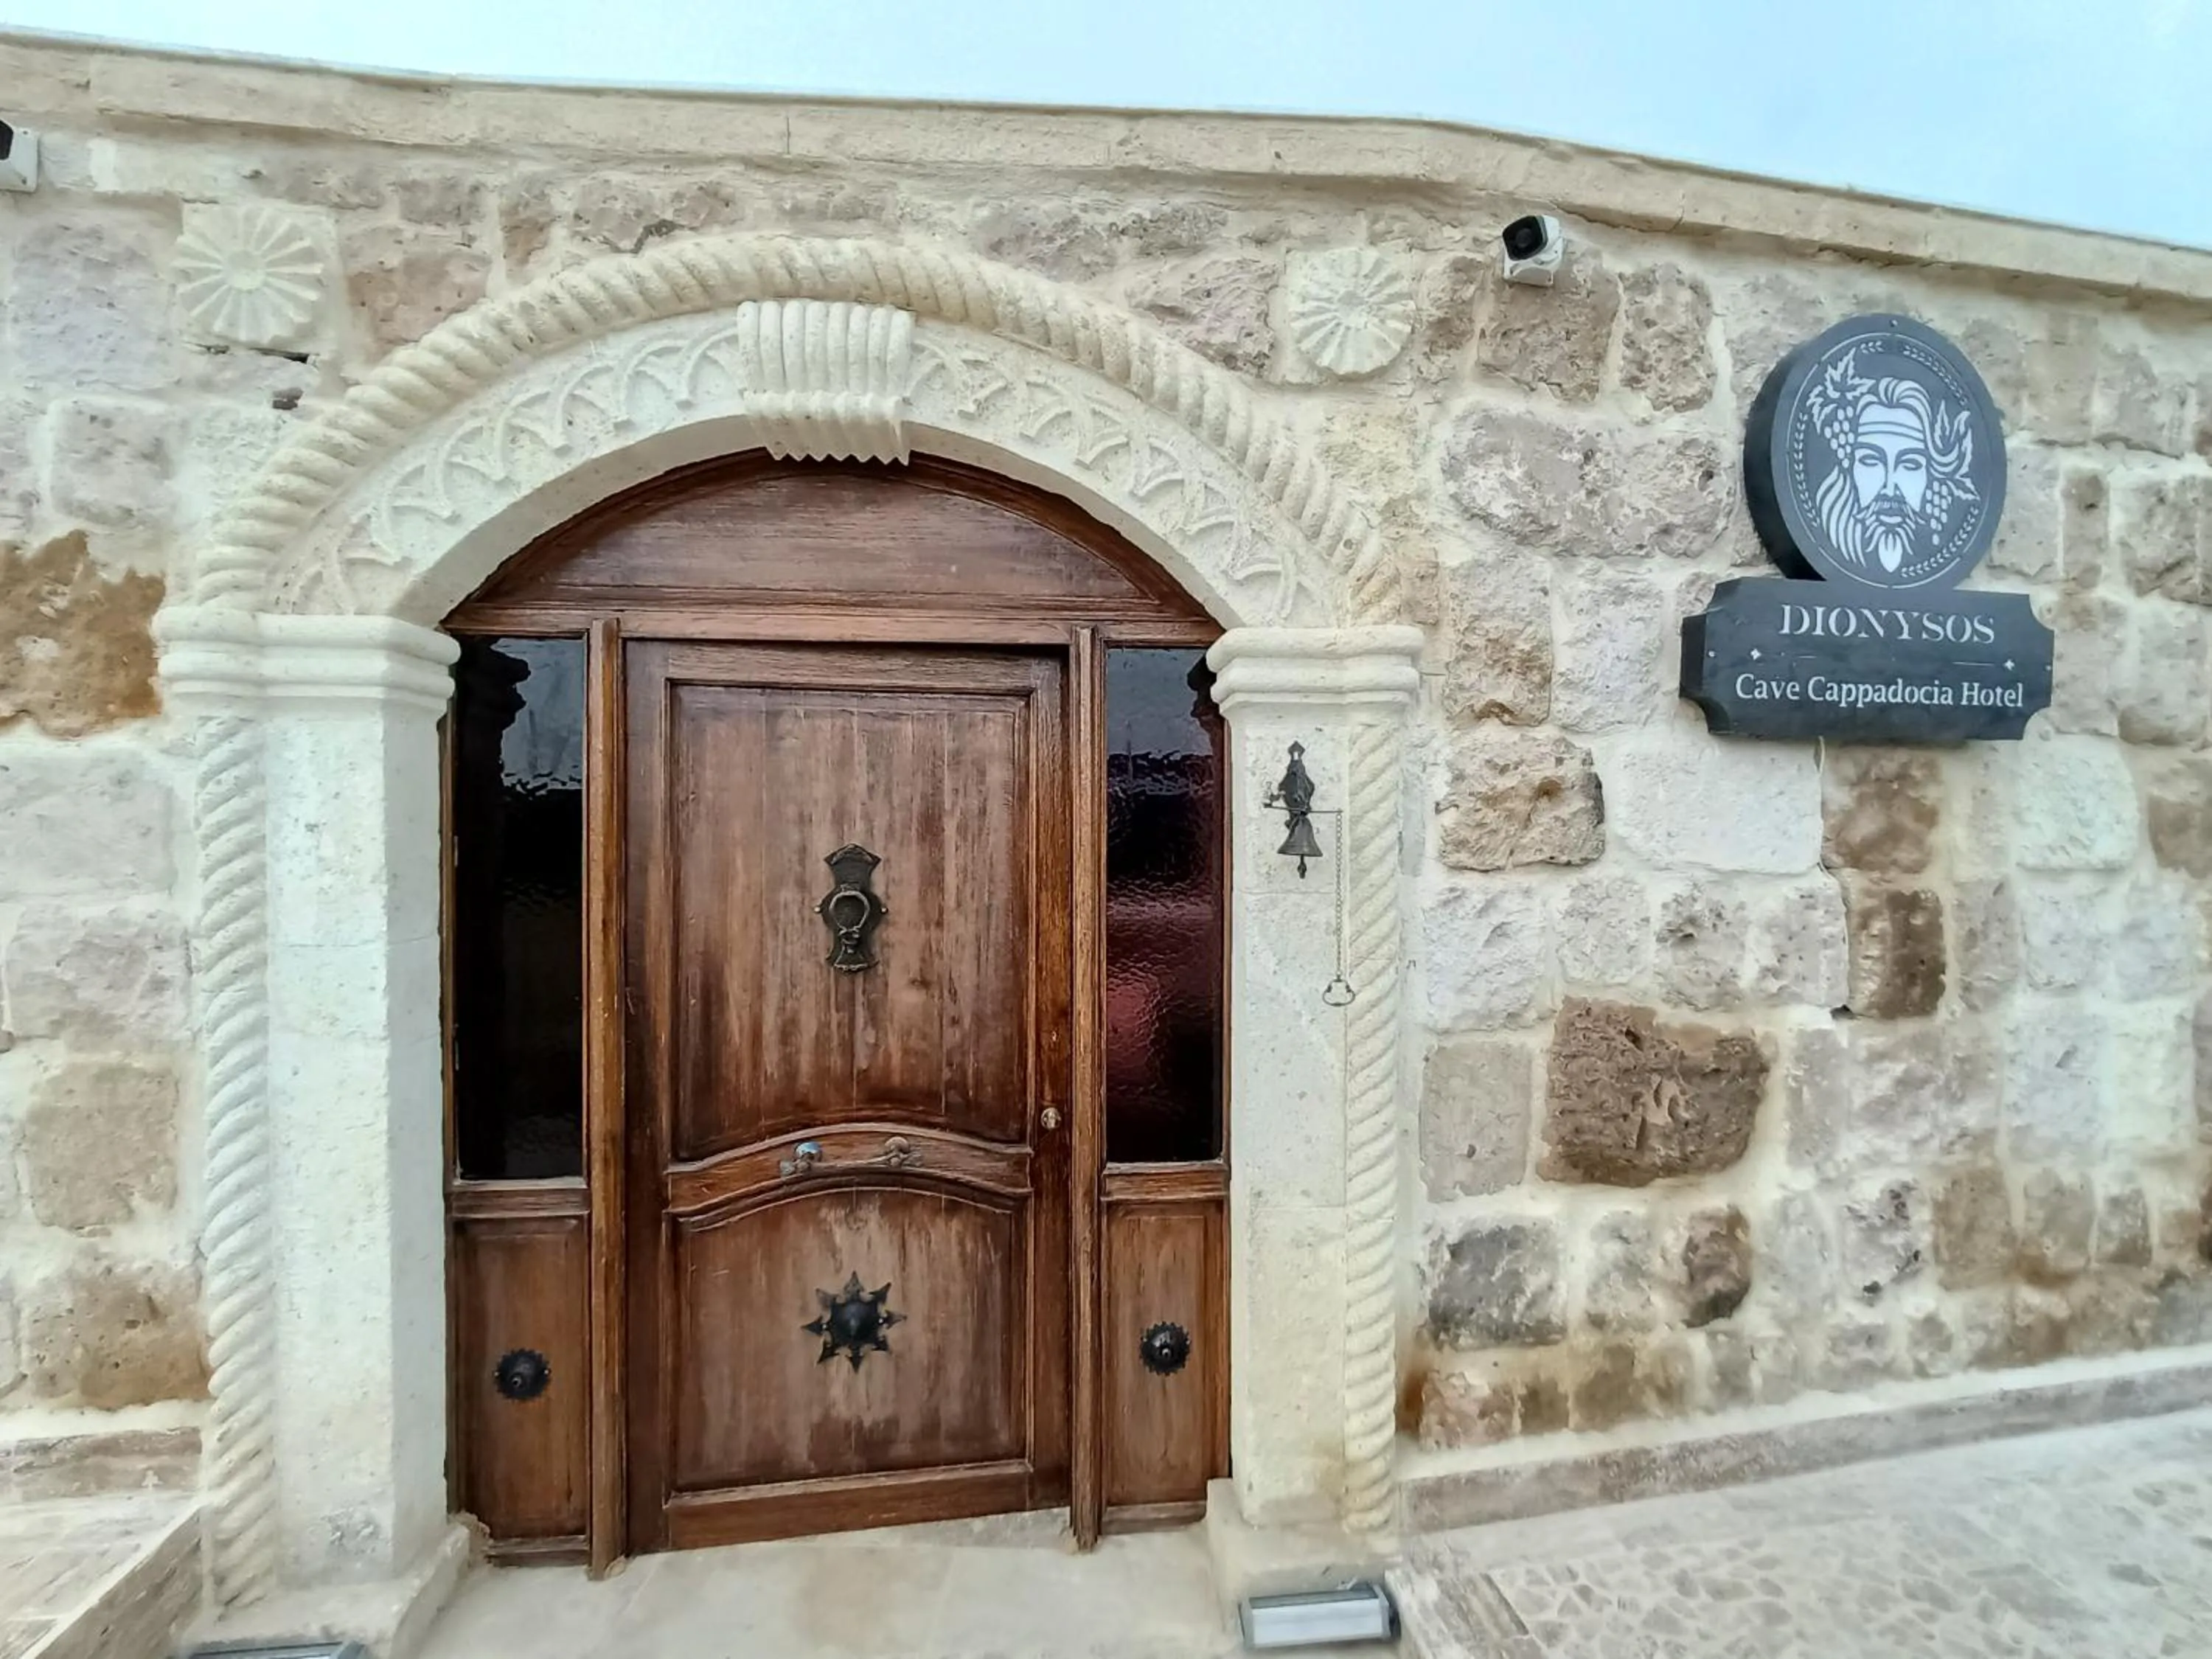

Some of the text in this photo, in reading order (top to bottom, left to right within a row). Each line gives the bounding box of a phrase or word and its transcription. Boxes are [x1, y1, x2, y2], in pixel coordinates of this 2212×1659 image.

[1778, 604, 1995, 644] DIONYSOS
[1735, 673, 2023, 708] Cave Cappadocia Hotel
